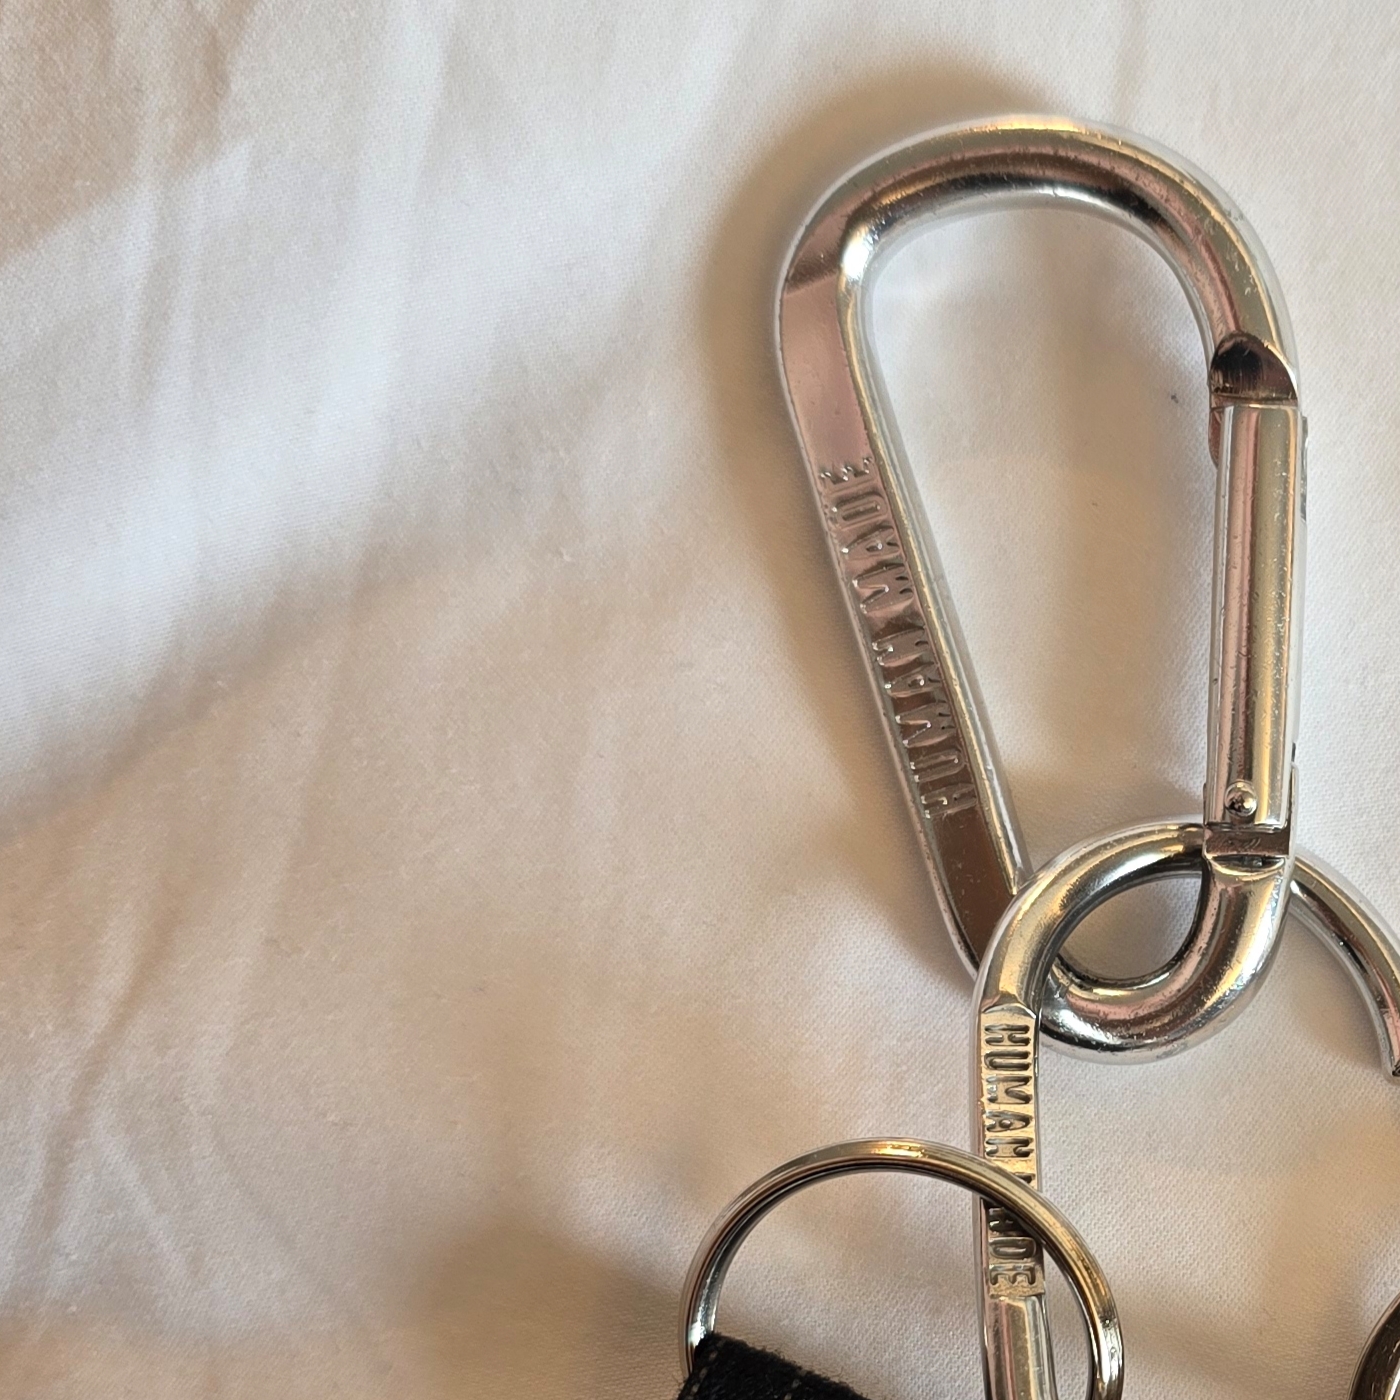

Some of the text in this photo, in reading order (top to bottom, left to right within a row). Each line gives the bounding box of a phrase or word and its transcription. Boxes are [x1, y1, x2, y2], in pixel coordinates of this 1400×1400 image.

[820, 456, 978, 819] HUMAN MADE
[983, 1023, 1035, 1158] HUMAN
